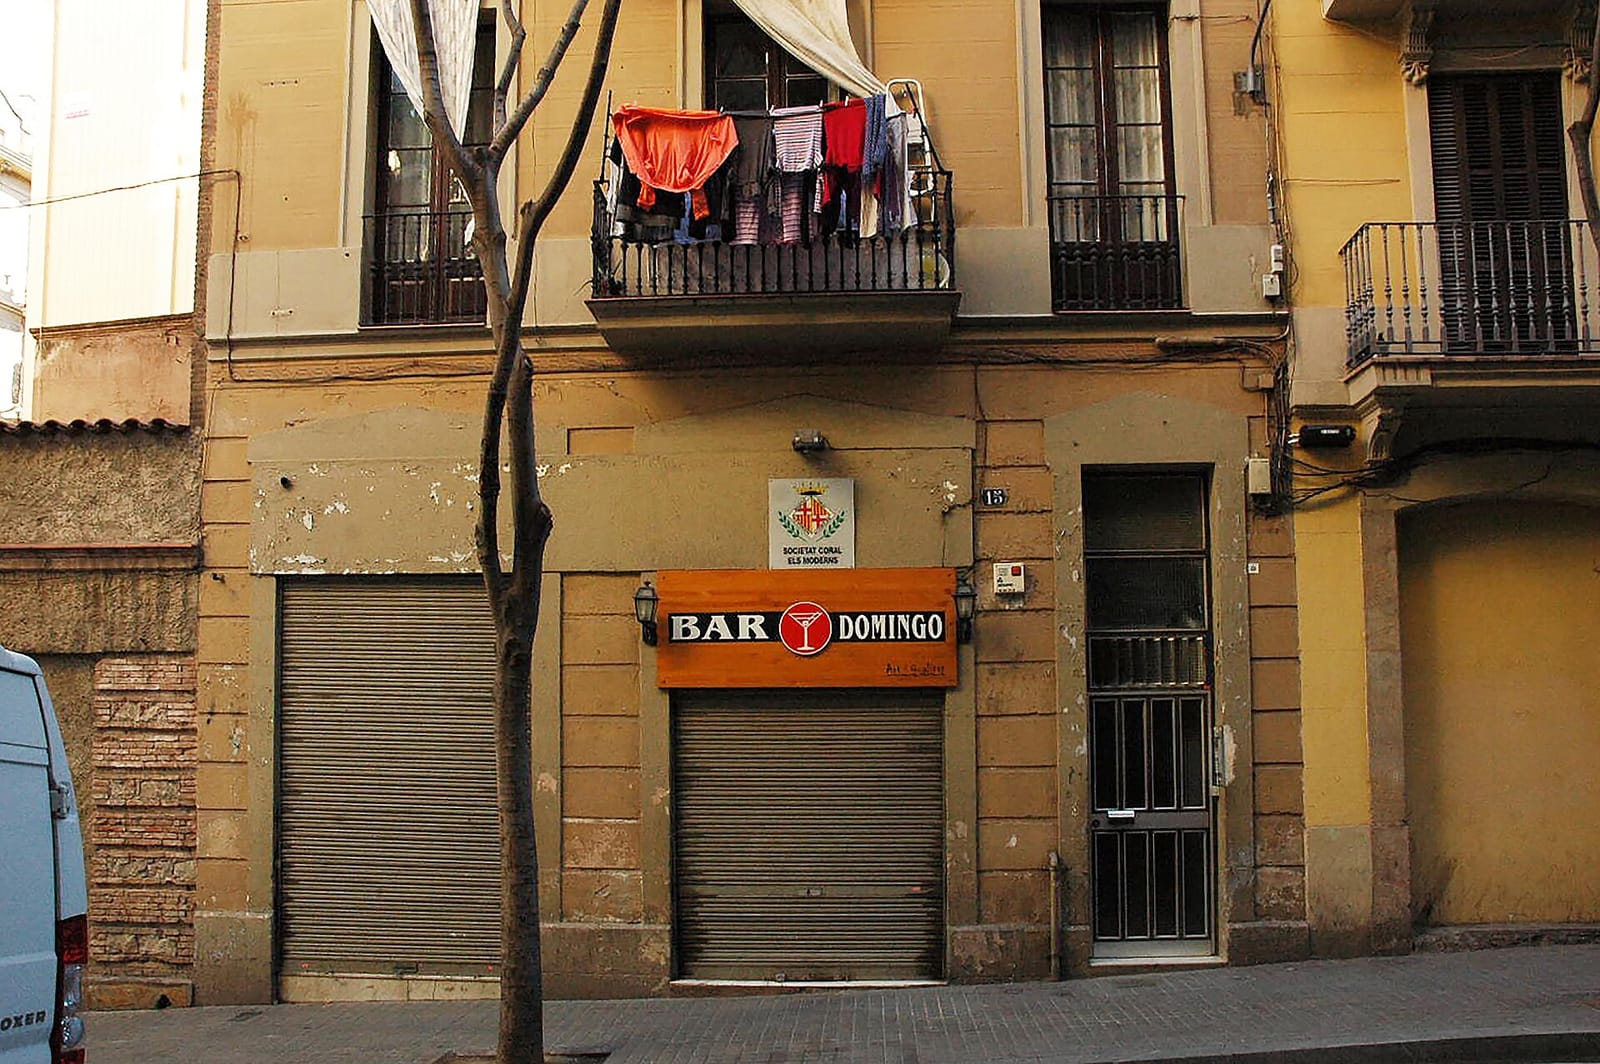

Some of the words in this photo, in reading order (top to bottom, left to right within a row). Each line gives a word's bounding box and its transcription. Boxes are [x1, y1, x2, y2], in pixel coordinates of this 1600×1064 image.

[987, 490, 1003, 505] 15
[783, 546, 817, 555] SOCIETAT
[818, 546, 843, 555] CORAL
[787, 556, 802, 565] ELS
[803, 556, 839, 565] MODERNS
[670, 614, 769, 641] BAR
[838, 613, 943, 640] DOMINGO
